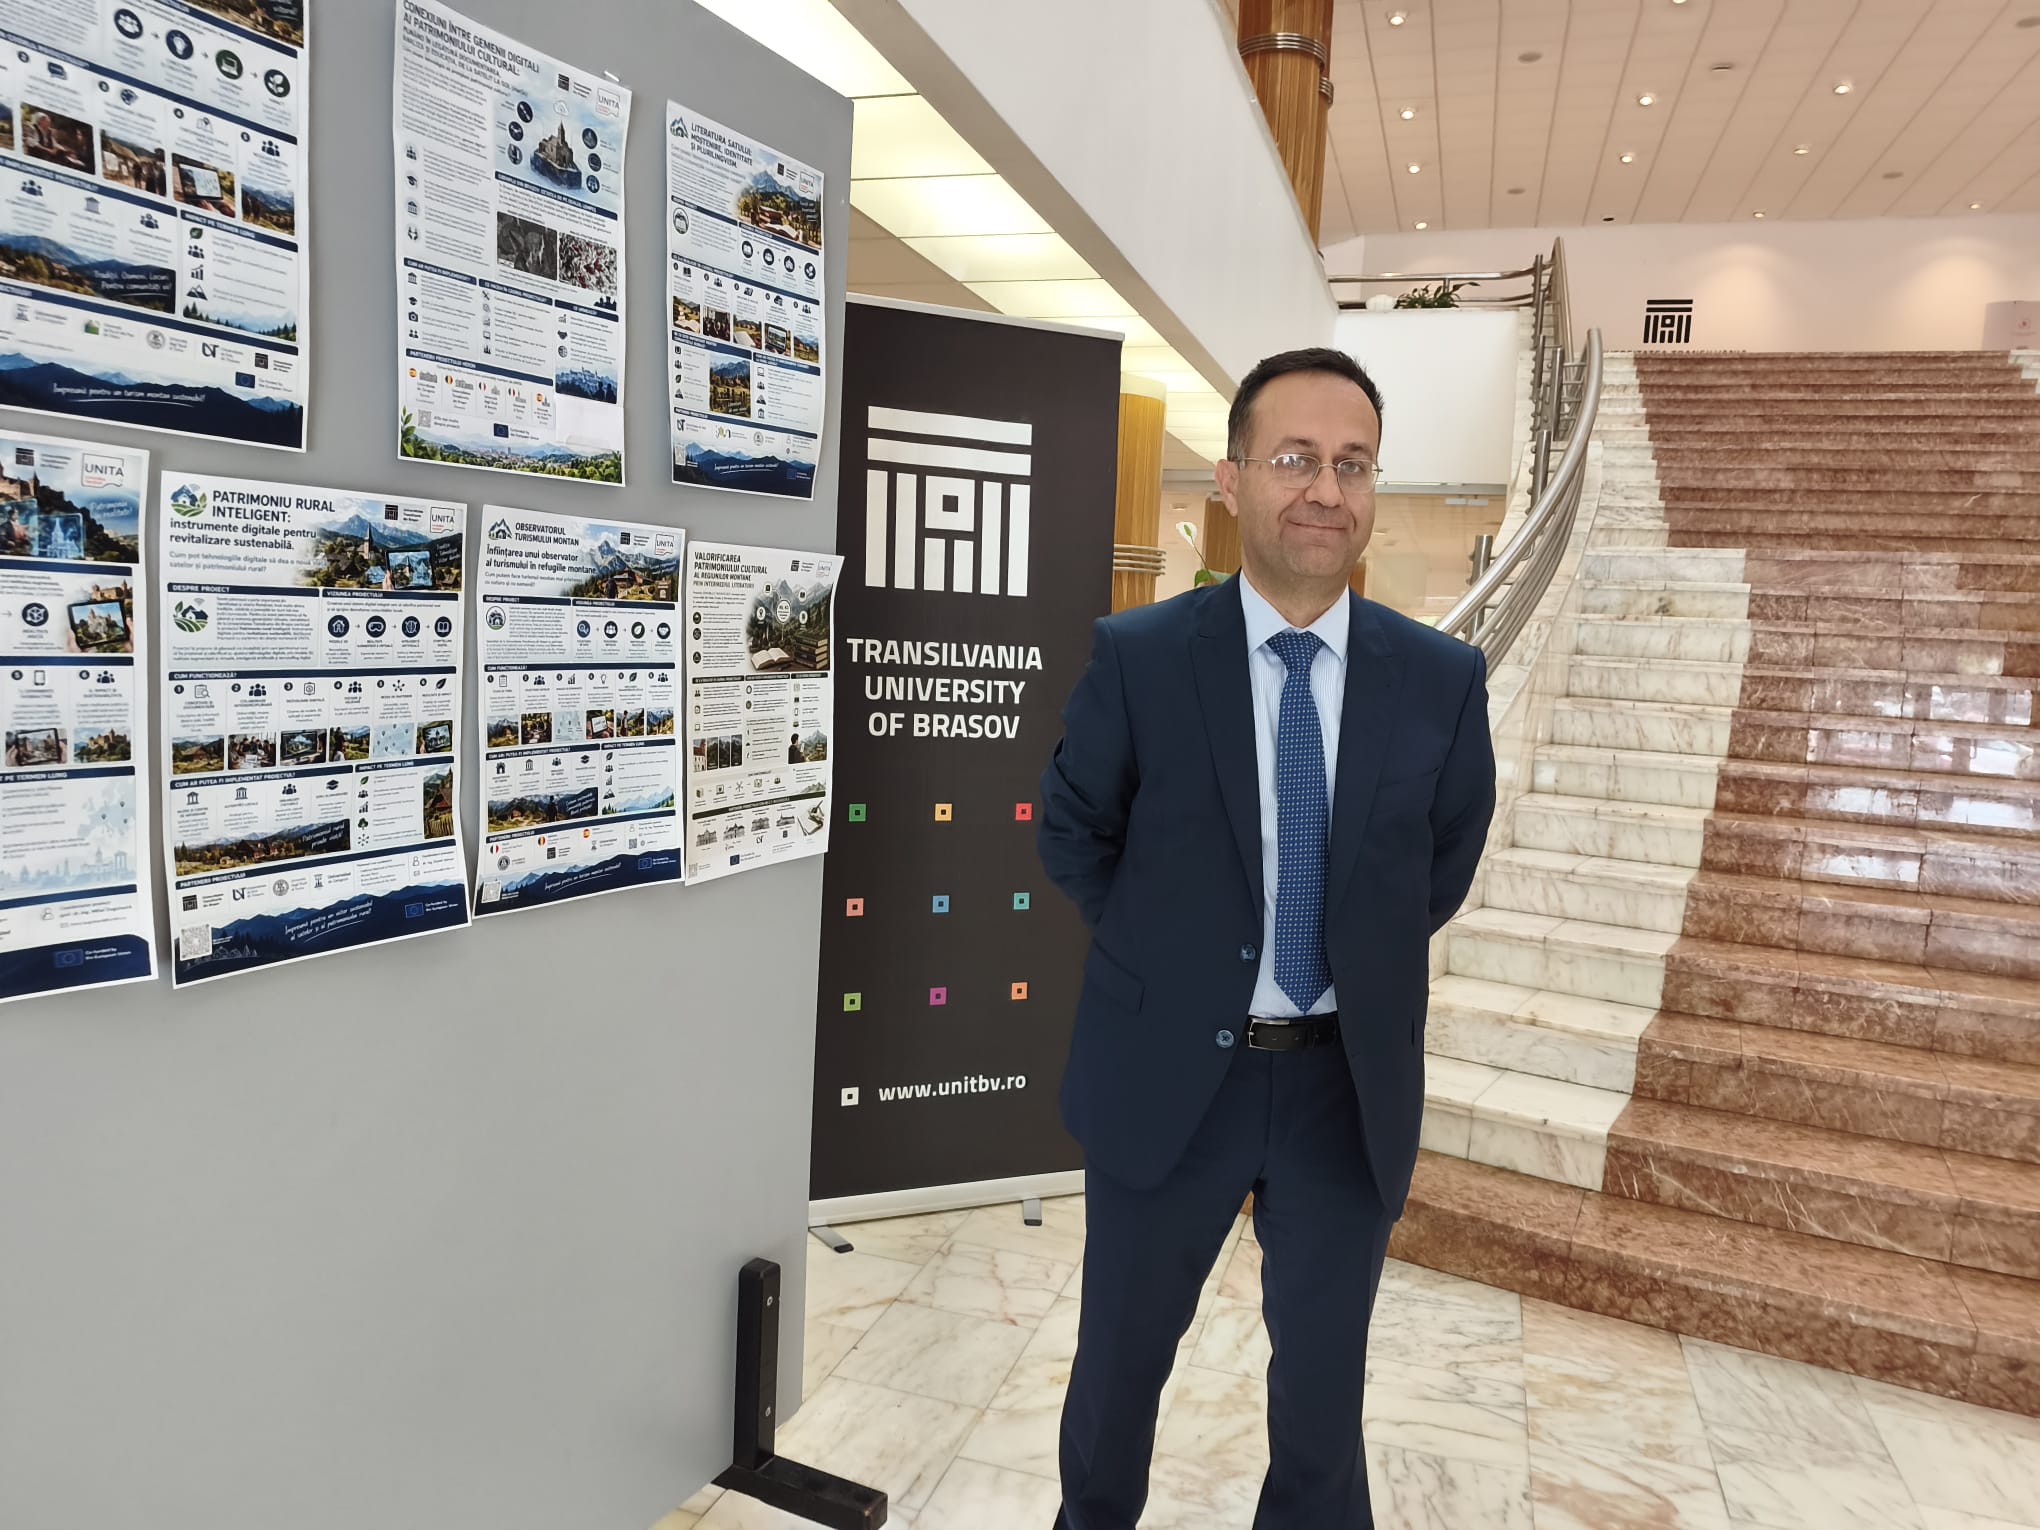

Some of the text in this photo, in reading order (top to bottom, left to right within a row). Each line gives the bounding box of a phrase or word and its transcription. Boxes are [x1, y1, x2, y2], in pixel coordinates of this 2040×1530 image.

[404, 0, 539, 73] CONEXIUNI ÎNTRE GEMENII DIGITALI
[414, 17, 476, 56] PATRIMONIULUI
[599, 95, 620, 109] UNITA
[692, 122, 726, 144] LITERATURA
[85, 464, 124, 476] UNITA
[213, 490, 335, 512] PATRIMONIU RURAL
[212, 506, 291, 522] INTELIGENT:
[432, 514, 454, 523] UNITA
[170, 518, 317, 540] instrumente digitale pentru
[516, 522, 566, 535] OBSERVATORUL
[170, 533, 294, 550] revitalizare sustenabilă.
[515, 532, 579, 546] TURISMULUI MONTAN
[525, 550, 540, 558] unui
[542, 550, 578, 561] observator
[694, 552, 741, 562] VALORIFICAREA
[486, 558, 492, 567] al
[494, 560, 528, 570] turismului
[530, 561, 536, 570] în
[694, 562, 768, 574] PATRIMONIULUI CULTURAL
[846, 637, 1044, 671] TRANSILVANIA
[864, 675, 1026, 705] UNIVERSITY
[868, 712, 1021, 739] OF BRASOV
[878, 1074, 1027, 1102] www.unitbv.ro
